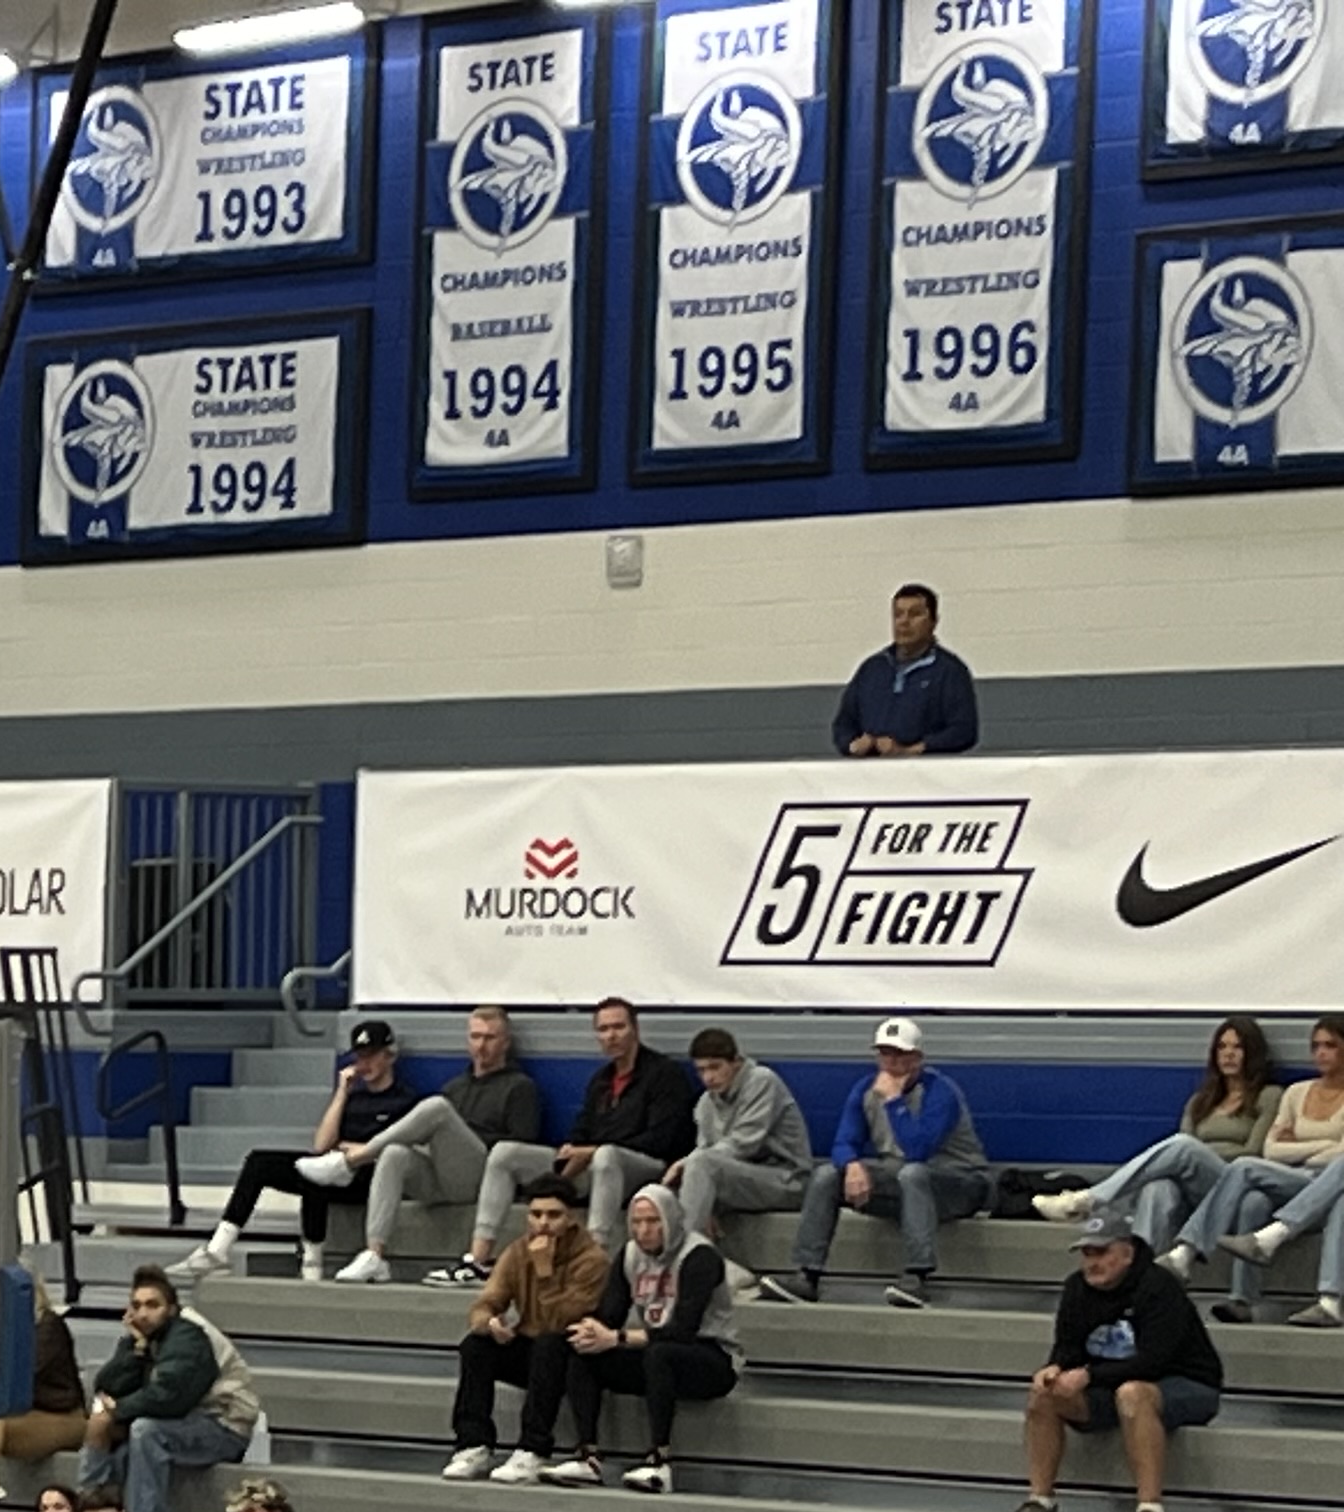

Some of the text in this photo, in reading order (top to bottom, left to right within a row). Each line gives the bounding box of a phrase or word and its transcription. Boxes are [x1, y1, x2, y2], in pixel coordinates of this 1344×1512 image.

[934, 0, 1034, 34] STATE
[694, 22, 789, 62] STATE
[467, 53, 556, 92] STATE
[203, 74, 307, 121] STATE
[199, 116, 306, 146] CHAMPIONS
[1228, 123, 1262, 145] 4A
[196, 147, 307, 177] WRESTLING
[194, 182, 308, 243] 1993
[901, 214, 1047, 248] CHAMPIONS
[668, 236, 802, 268] CHAMPIONS
[440, 261, 567, 294] CHAMPIONS
[903, 269, 1040, 298] WRESTLING
[669, 290, 797, 320] WRESTLING
[450, 314, 553, 343] BASEBALL
[901, 320, 1038, 382] 1996
[194, 351, 298, 396] STATE
[668, 339, 794, 402] 1995
[443, 359, 561, 420] 1994
[948, 393, 980, 413] 4A
[191, 394, 297, 420] CHAMPIONS
[711, 410, 740, 431] 4A
[190, 424, 297, 450] WRESTLING
[484, 428, 510, 449] 4A
[1217, 445, 1248, 466] 4A
[185, 458, 298, 517] 1994
[870, 820, 1000, 855] FOR THE
[755, 825, 841, 945] 5
[464, 886, 635, 919] MURDOCK
[836, 890, 1002, 946] FIGHT
